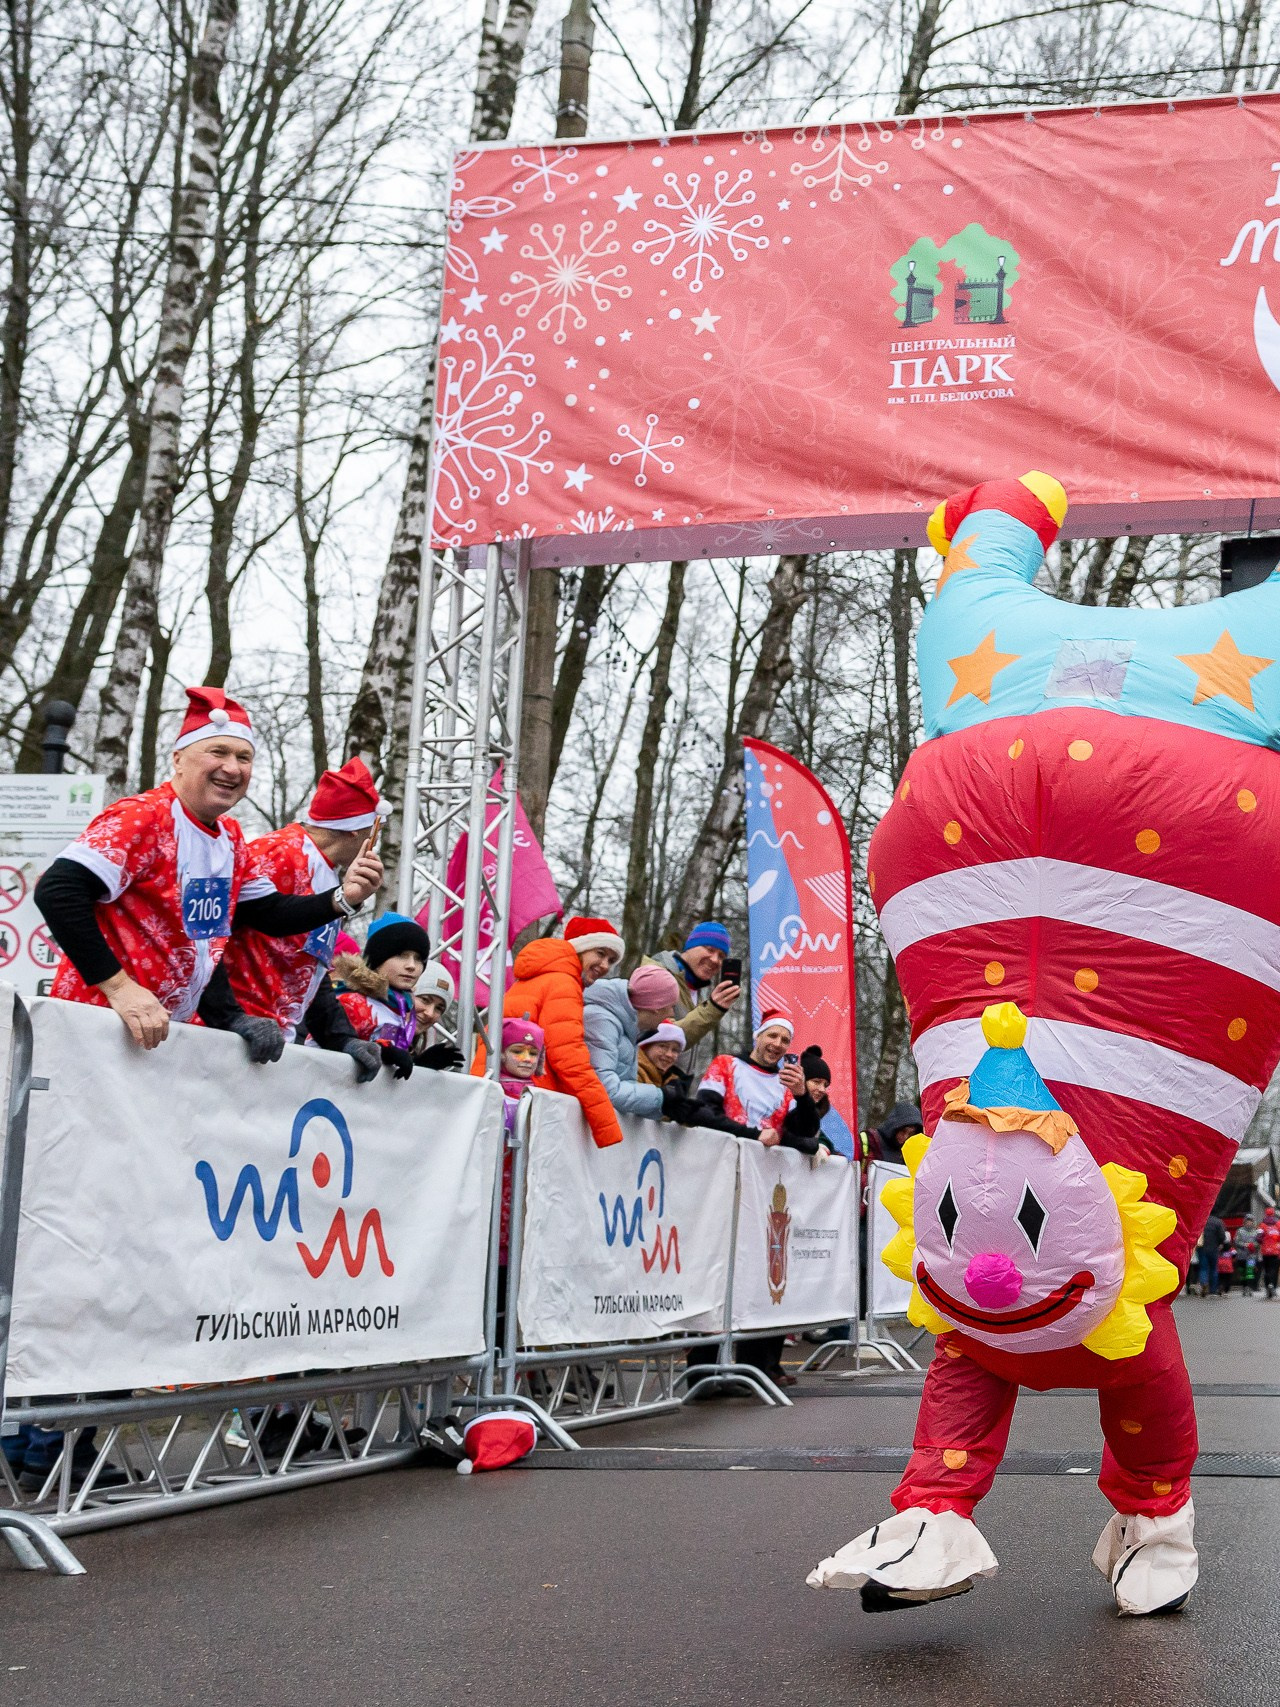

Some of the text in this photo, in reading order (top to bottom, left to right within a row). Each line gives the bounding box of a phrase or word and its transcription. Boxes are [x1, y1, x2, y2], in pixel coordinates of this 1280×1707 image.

[889, 334, 1016, 355] ЦЕНТРАЛЬНЫЙ
[887, 353, 1016, 390] ПАРК
[939, 387, 1015, 403] БЕЛОУСОВА
[187, 896, 222, 922] 2106
[594, 1289, 685, 1315] ТУЛЬСКИЙ МАРАФОН
[195, 1302, 400, 1342] ТУЛЬСКИЙ МАРАФОН
